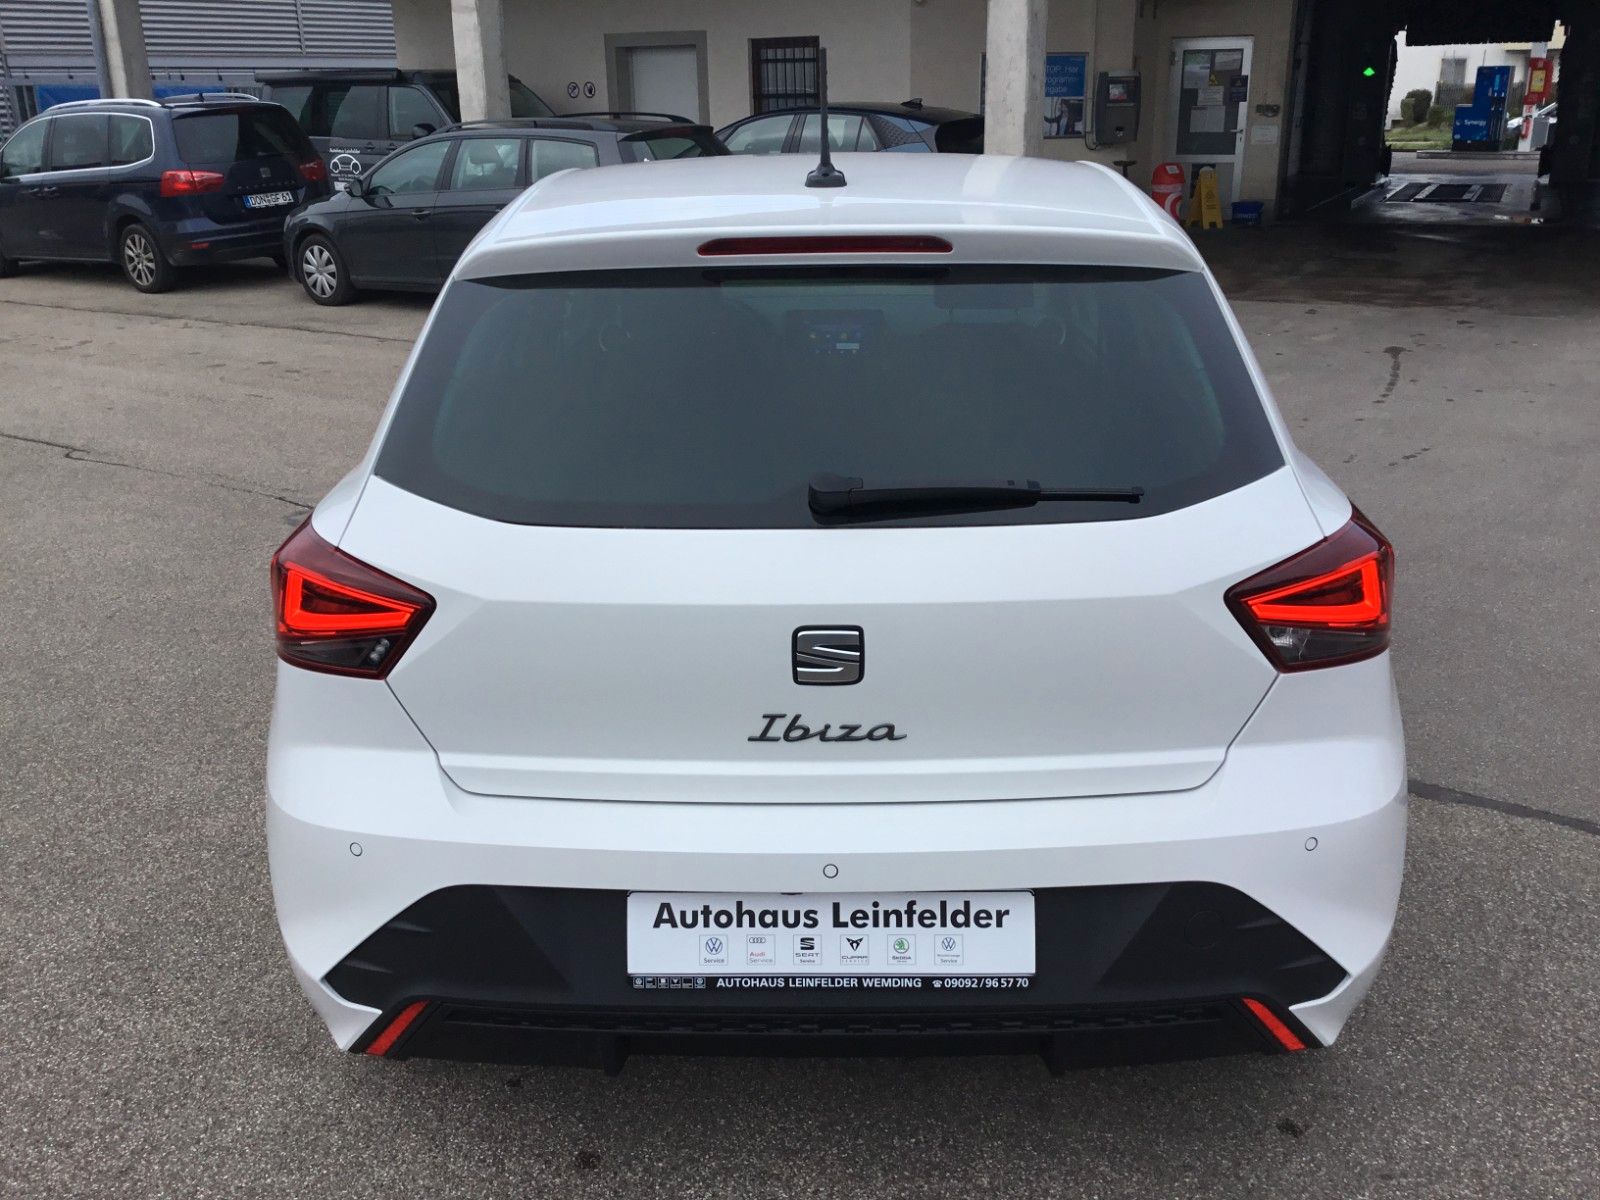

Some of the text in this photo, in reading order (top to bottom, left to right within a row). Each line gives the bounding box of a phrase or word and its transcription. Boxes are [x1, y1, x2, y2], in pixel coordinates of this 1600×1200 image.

[1464, 119, 1487, 127] Synergy
[747, 713, 908, 742] Ibiza
[653, 900, 1010, 929] Autohaus Leinfelder
[716, 977, 785, 988] AUTOHAUS
[788, 977, 858, 988] LEINFELDER
[862, 978, 922, 988] WEMDING
